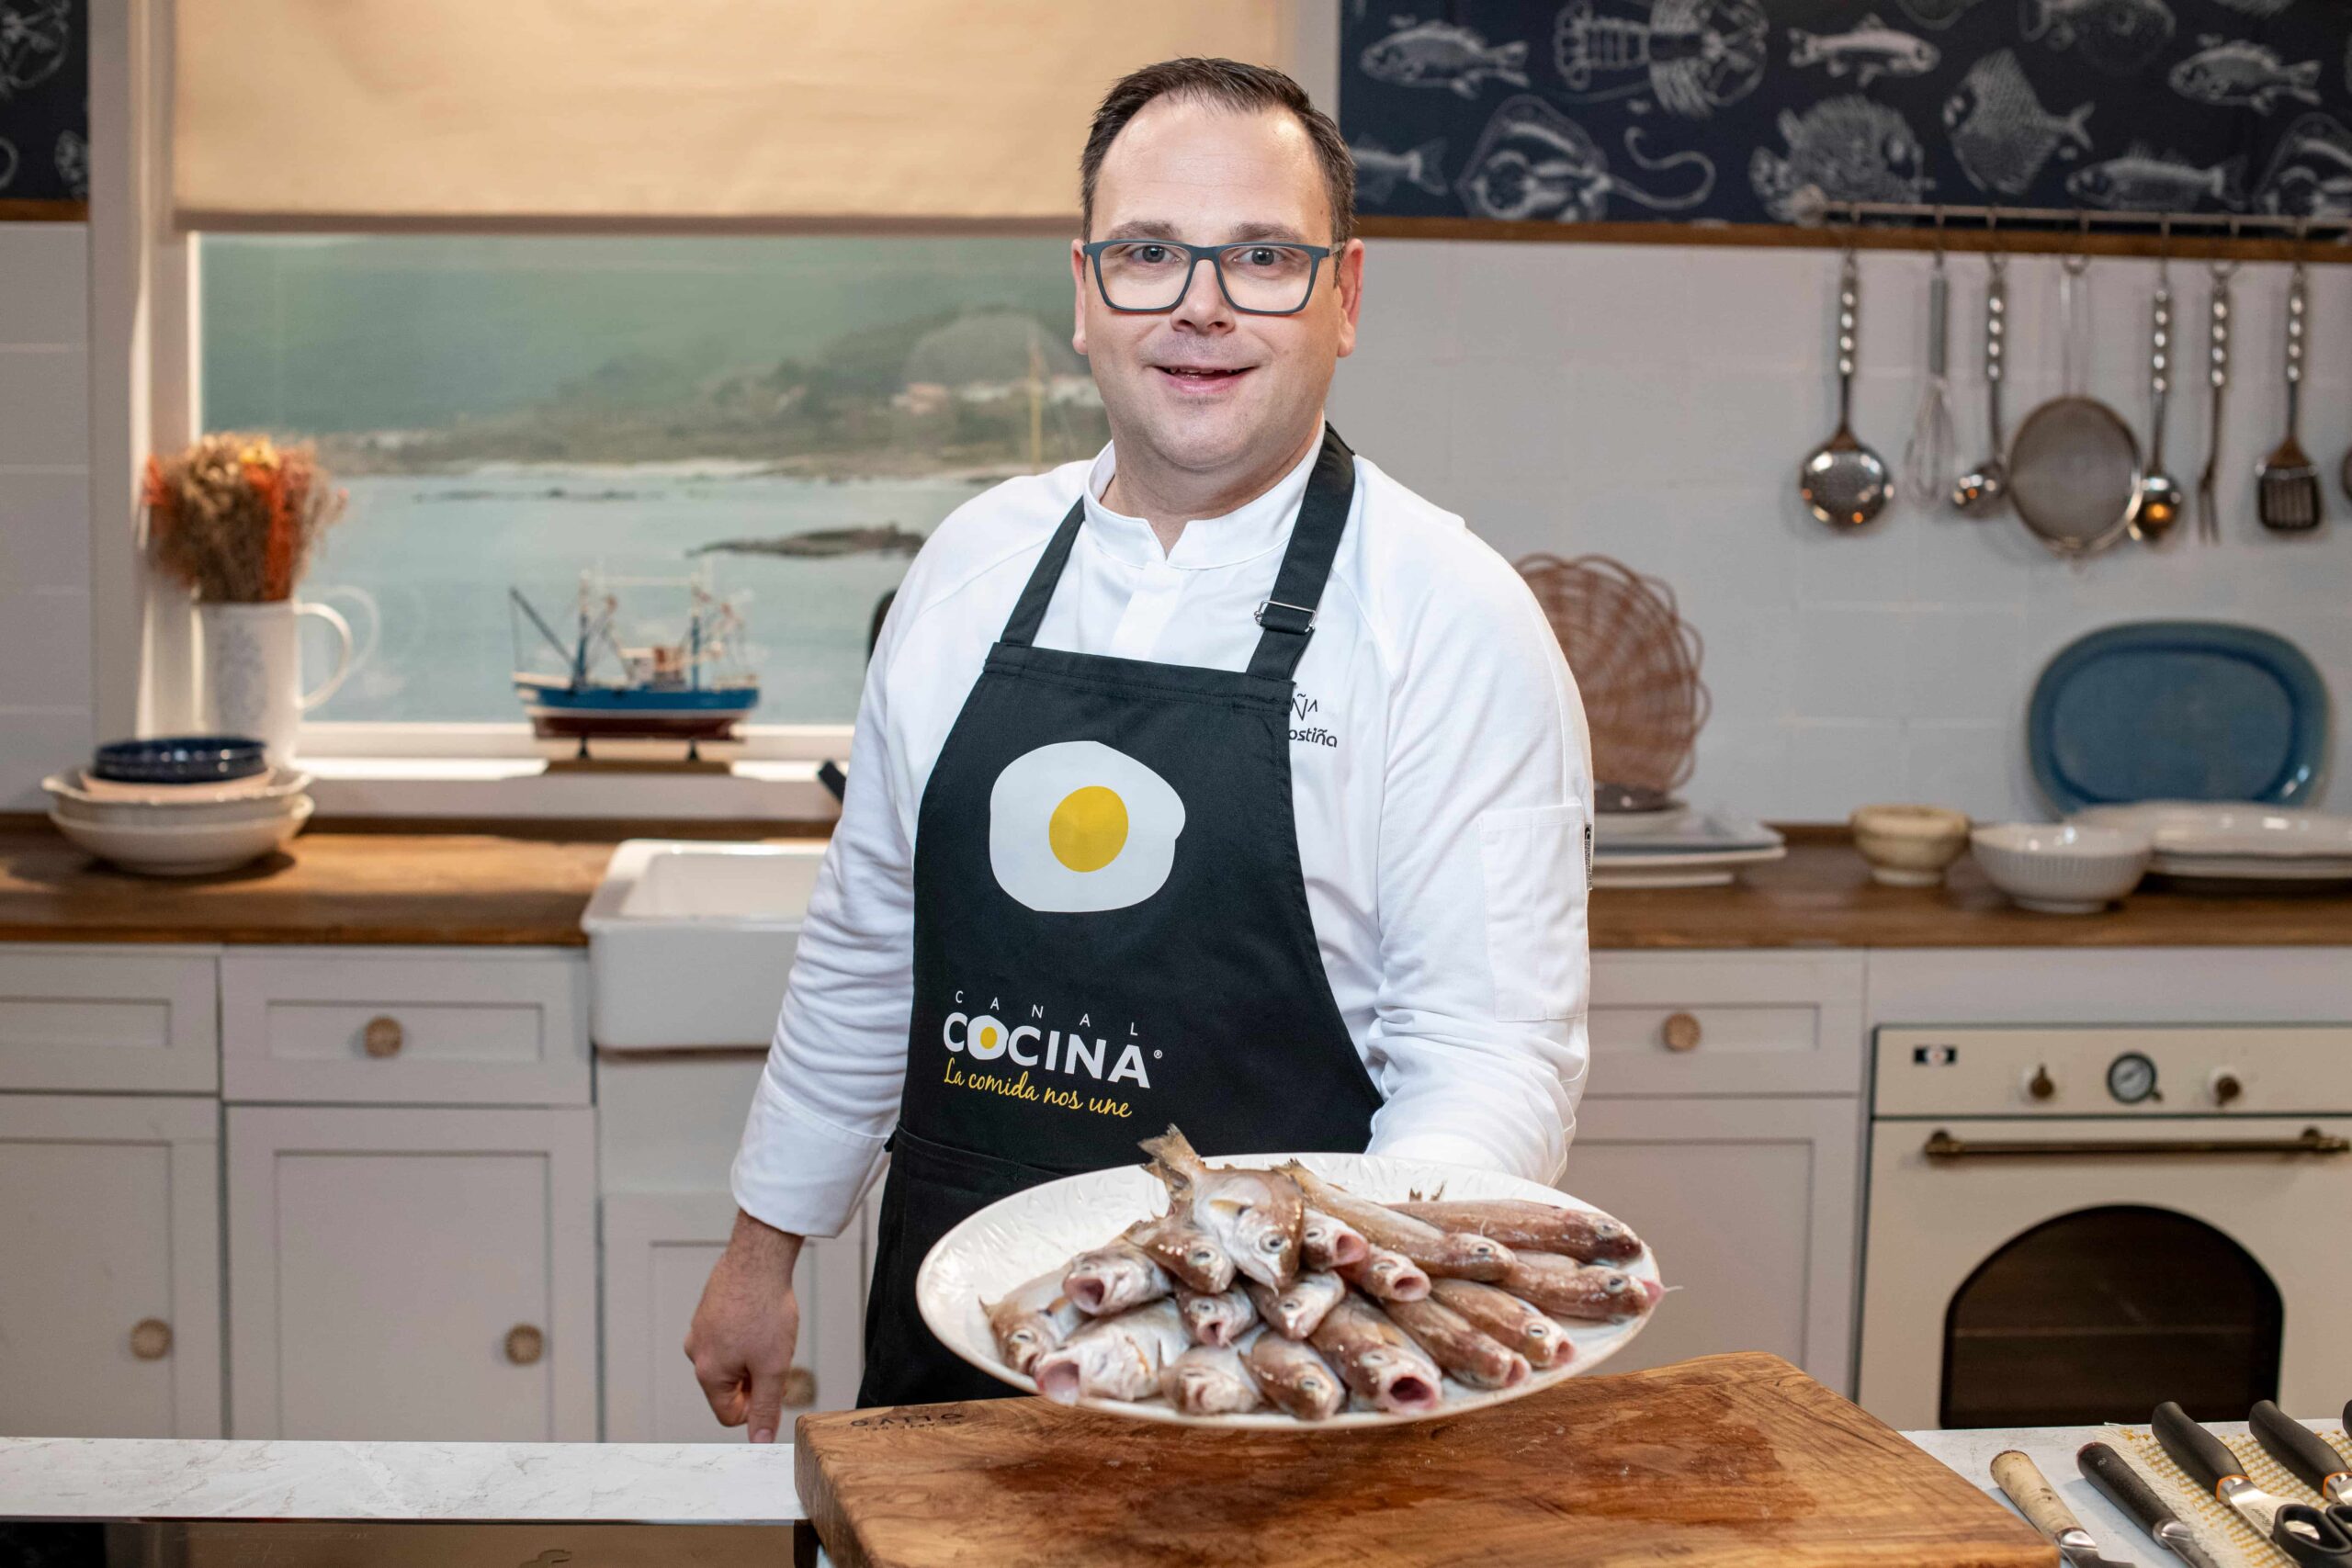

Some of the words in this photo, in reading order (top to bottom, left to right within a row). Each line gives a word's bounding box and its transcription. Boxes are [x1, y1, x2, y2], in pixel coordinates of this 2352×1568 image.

[1288, 728, 1338, 749] ostiña
[956, 990, 1138, 1036] CANAL
[944, 1057, 965, 1086] La
[968, 1070, 1040, 1101] comida
[1044, 1087, 1083, 1110] nos
[1089, 1098, 1132, 1118] une
